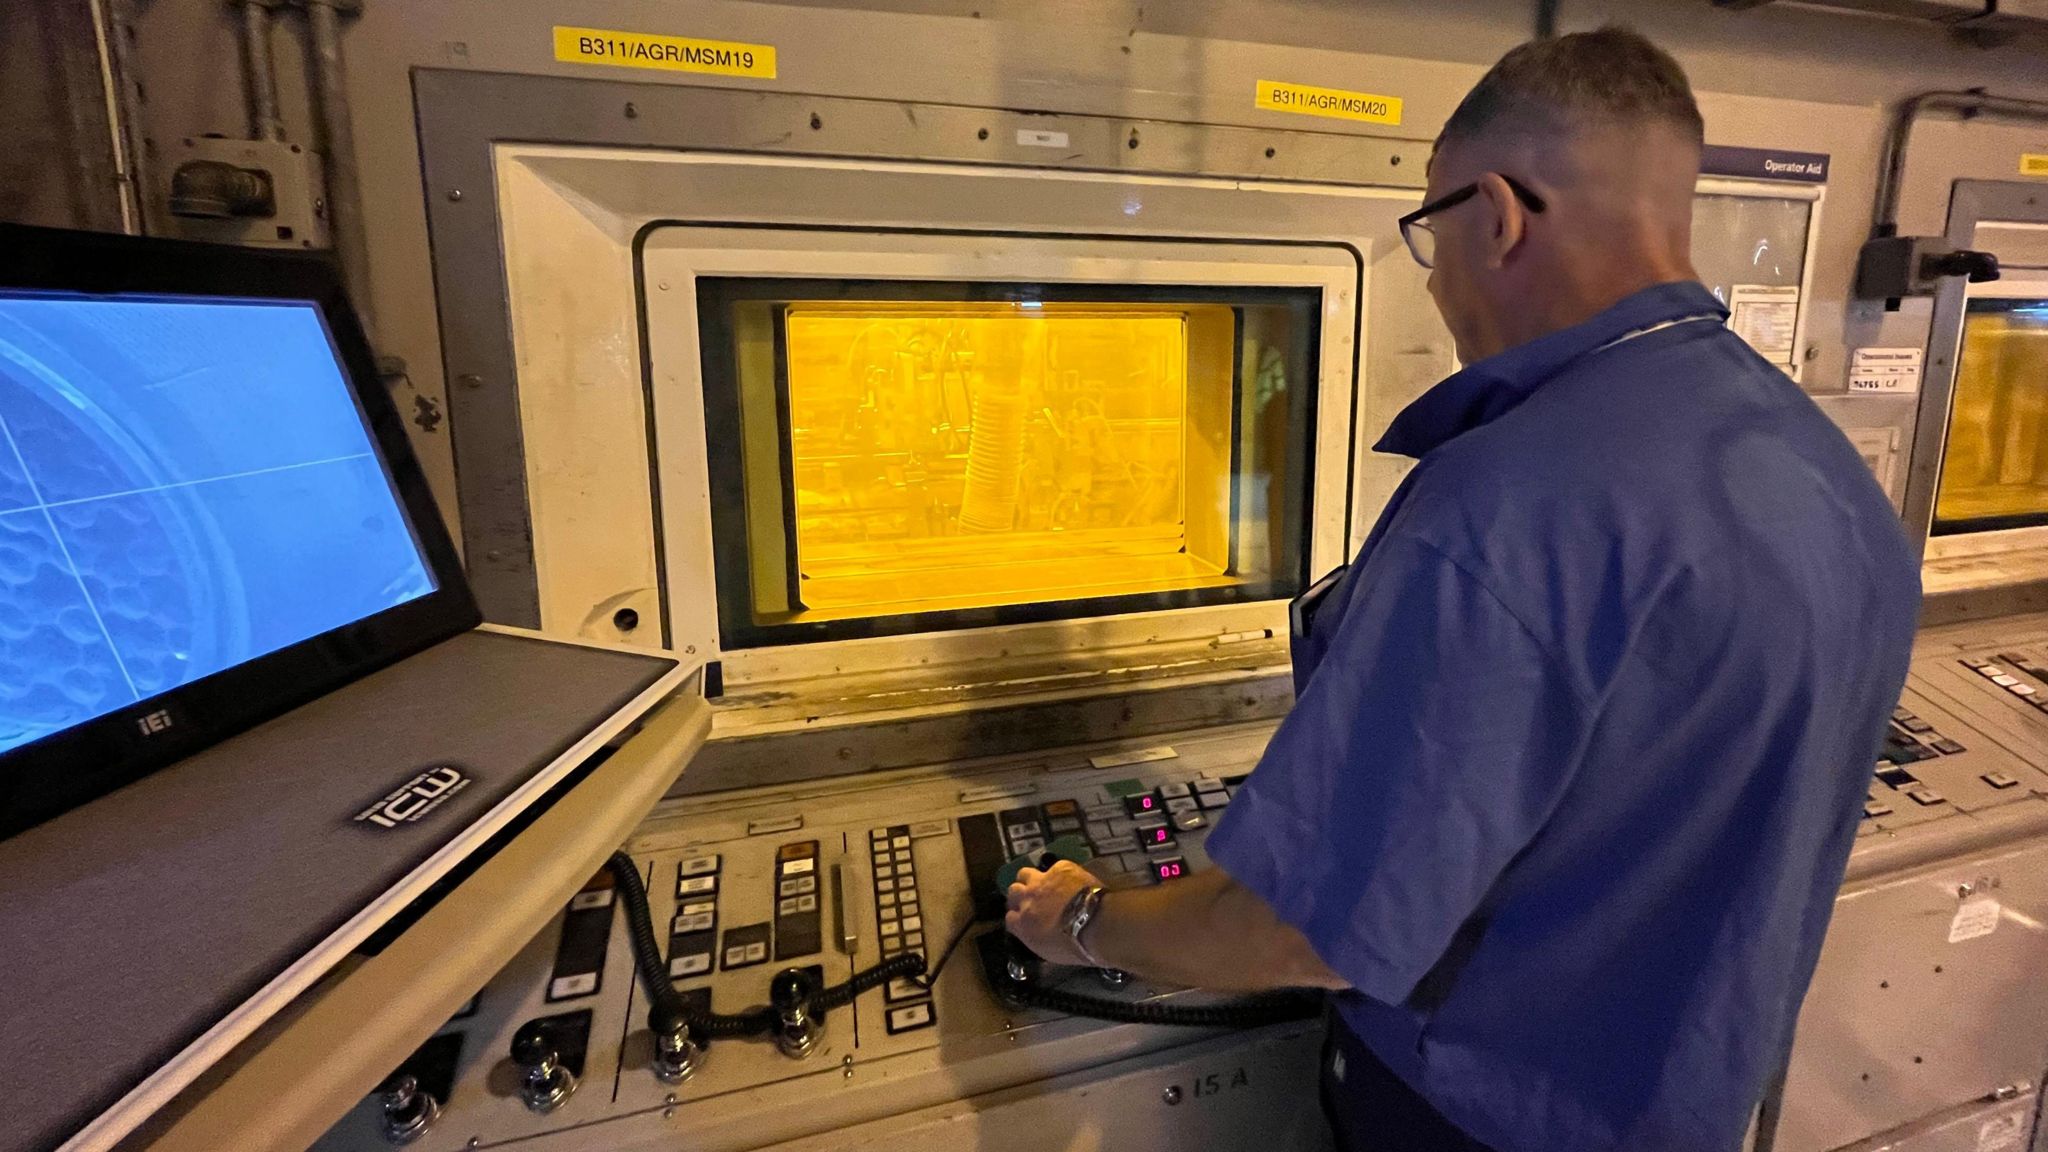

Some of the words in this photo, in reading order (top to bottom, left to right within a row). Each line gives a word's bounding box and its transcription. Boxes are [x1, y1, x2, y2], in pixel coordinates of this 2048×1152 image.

[579, 37, 754, 69] B311/AGR/MSM19
[1272, 89, 1387, 116] B311/AGR/MSM20
[1765, 159, 1805, 173] Operator
[1806, 163, 1823, 175] Aid
[1194, 1074, 1220, 1098] 15
[1231, 1066, 1249, 1089] A
